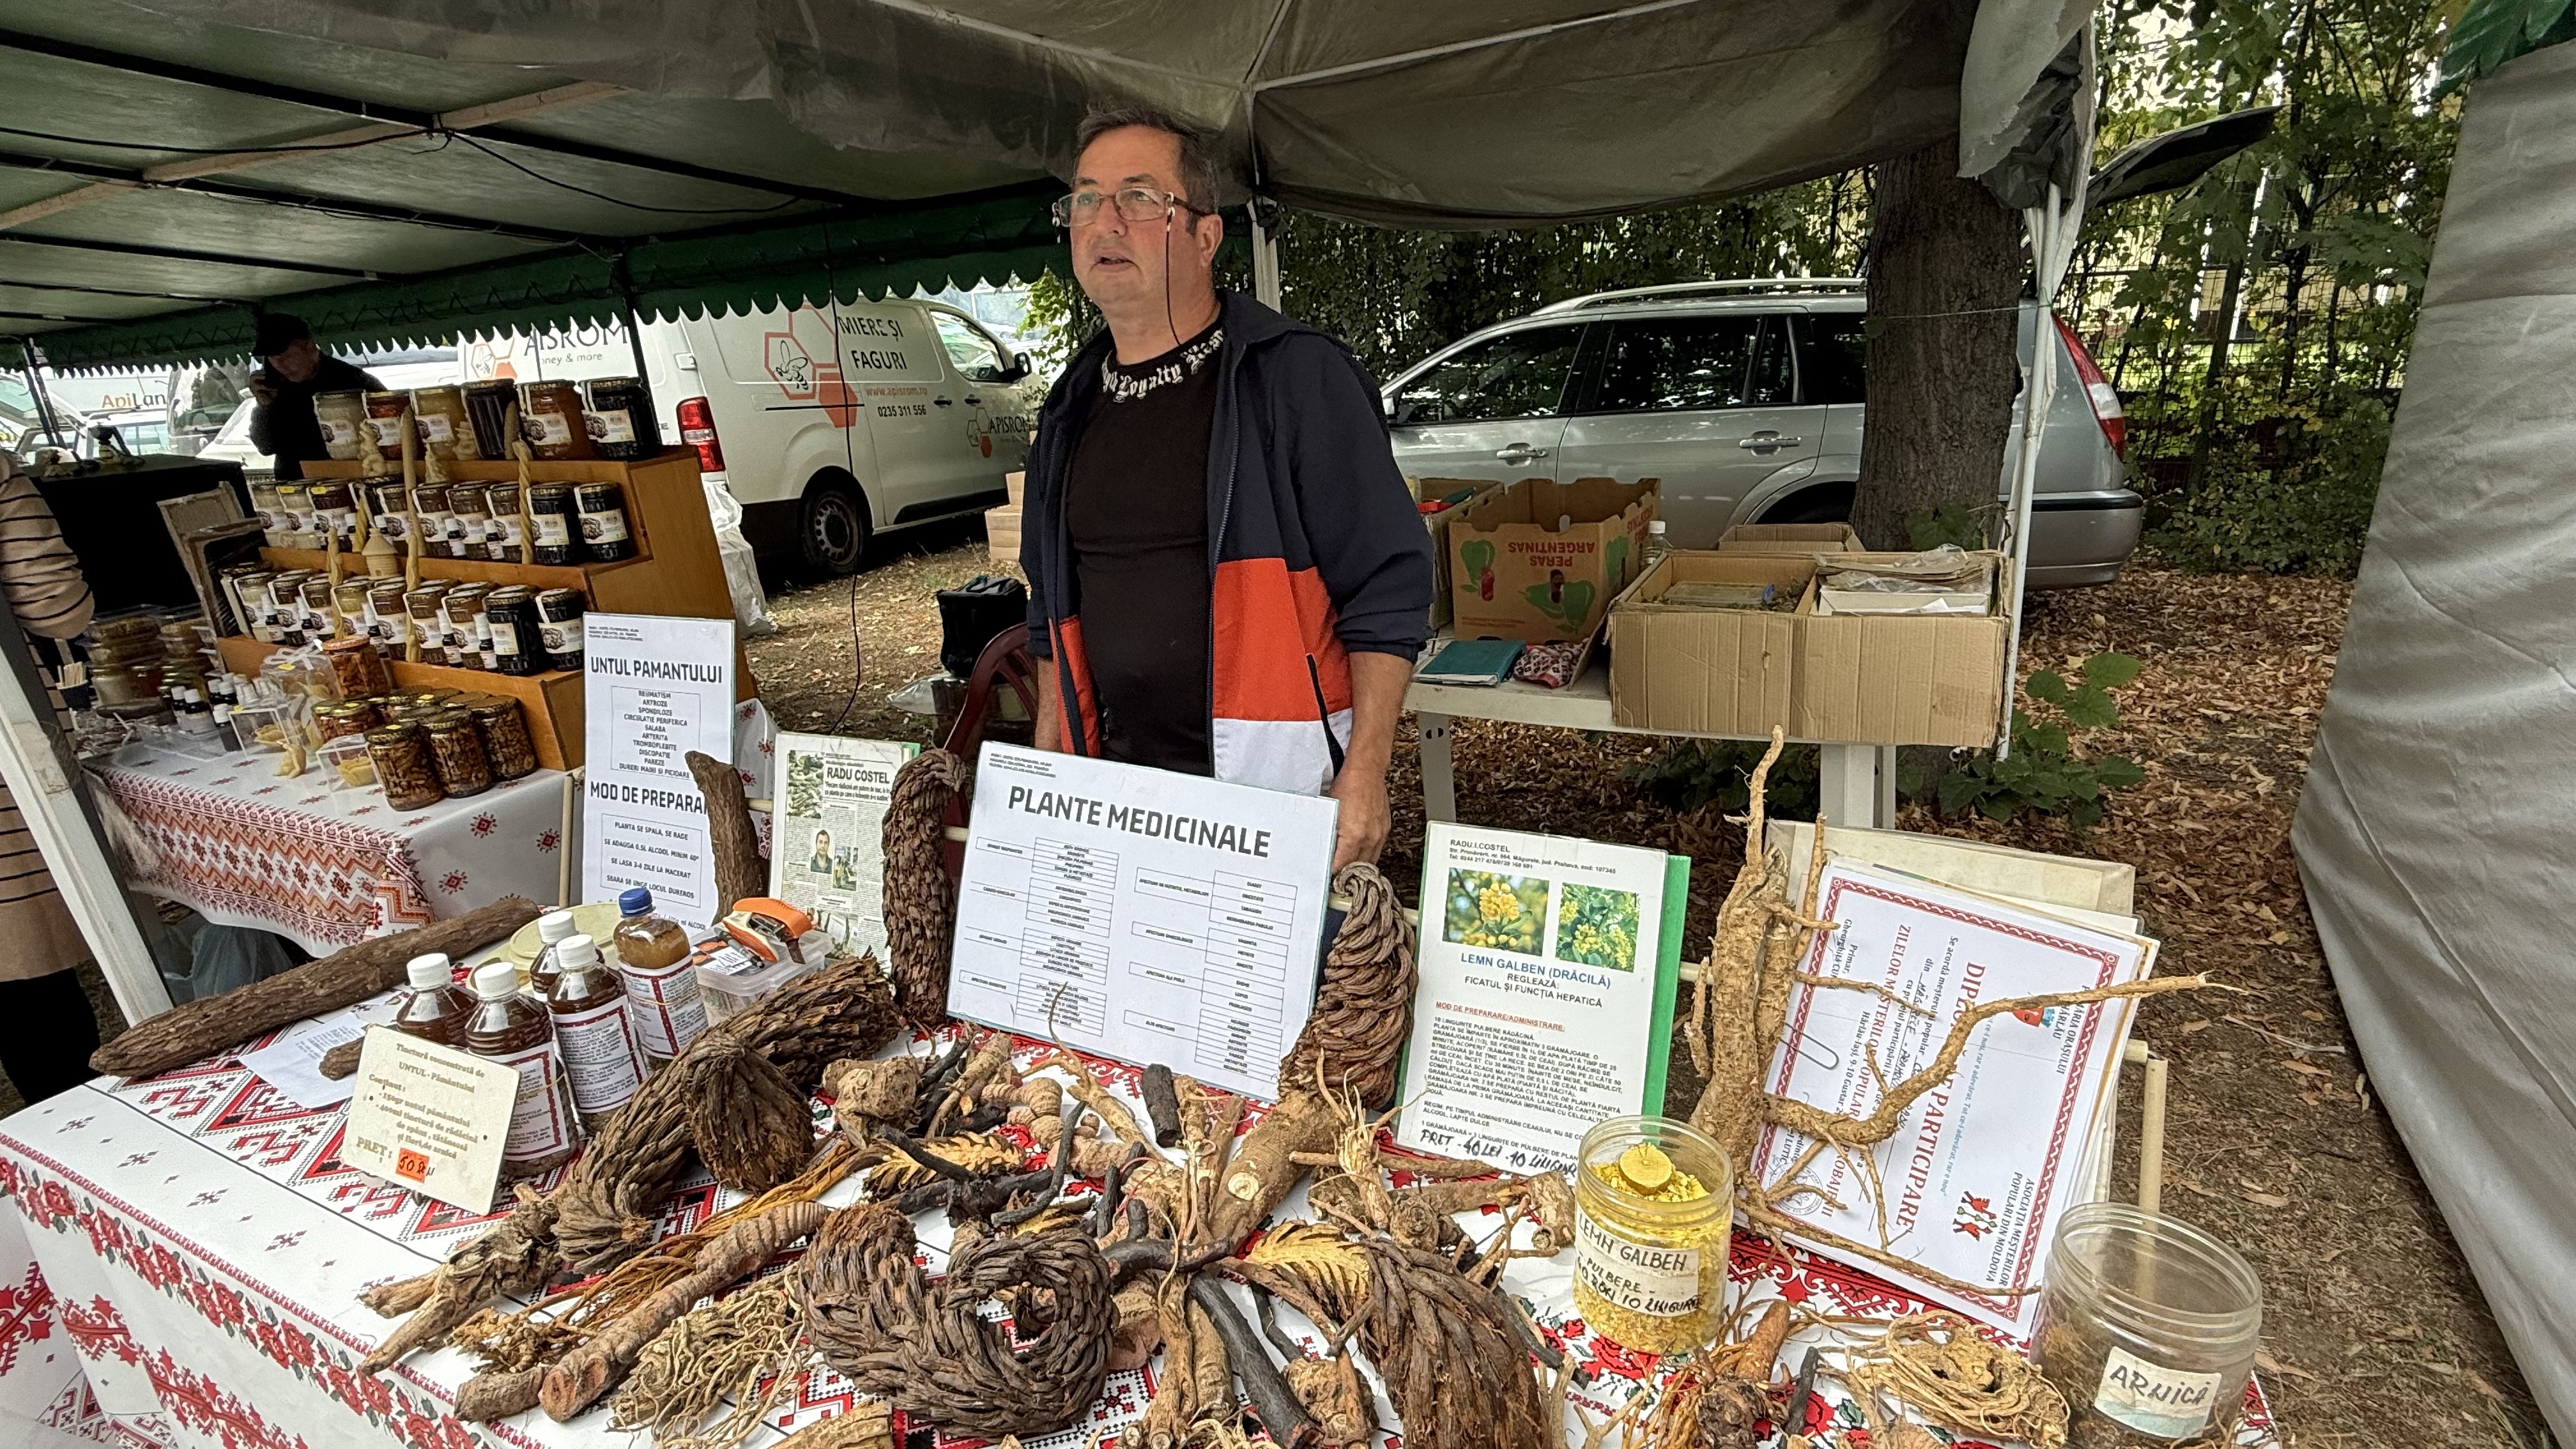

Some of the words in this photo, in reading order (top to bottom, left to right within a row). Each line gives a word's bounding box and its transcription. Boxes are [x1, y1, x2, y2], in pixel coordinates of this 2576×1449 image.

[838, 316, 887, 337] MIERE
[577, 353, 602, 361] more
[851, 350, 907, 369] FAGURI
[866, 387, 928, 397] www.apisrom.ro
[878, 406, 896, 417] 0235
[899, 406, 912, 417] 311
[914, 405, 926, 415] 556
[1508, 542, 1595, 553] ARGENTINAS
[1529, 555, 1573, 567] PERAS
[591, 656, 631, 675] UNTUL
[634, 660, 721, 683] PAMANTULUI
[827, 767, 852, 781] RADU
[855, 768, 889, 784] COSTEL
[590, 781, 618, 801] MOD
[622, 785, 638, 803] DE
[1008, 786, 1103, 826] PLANTE
[1107, 804, 1271, 858] MEDICINALE
[648, 846, 669, 855] ALCOOL
[1887, 923, 1911, 977] ZILELOR
[1947, 935, 1958, 947] Se
[1842, 943, 1858, 976] Primar,
[1923, 958, 1934, 973] din
[1939, 946, 1955, 976] acordă
[1460, 952, 1493, 967] LEMN
[1496, 958, 1545, 976] GALBEN
[1548, 965, 1611, 990] (DRĂCILĂ)
[1464, 976, 1501, 990] FICATUL
[1556, 990, 1603, 1008] HEPATICĂ
[1905, 979, 1913, 990] cu
[1436, 1001, 1452, 1010] MOD
[1917, 1022, 1935, 1057] popular
[2054, 1029, 2076, 1075] ORAȘULUI
[399, 1061, 426, 1077] UNTUL
[1481, 1143, 1502, 1157] LEI
[1896, 1089, 1949, 1231] PARTICIPARE
[2002, 1171, 2023, 1218] POPULARI
[2012, 1177, 2035, 1228] ASOCIAȚIA
[1998, 1219, 2010, 1236] DIN
[1985, 1236, 2005, 1283] MOLDOVA
[1997, 1227, 2021, 1287] MEȘTERILOR
